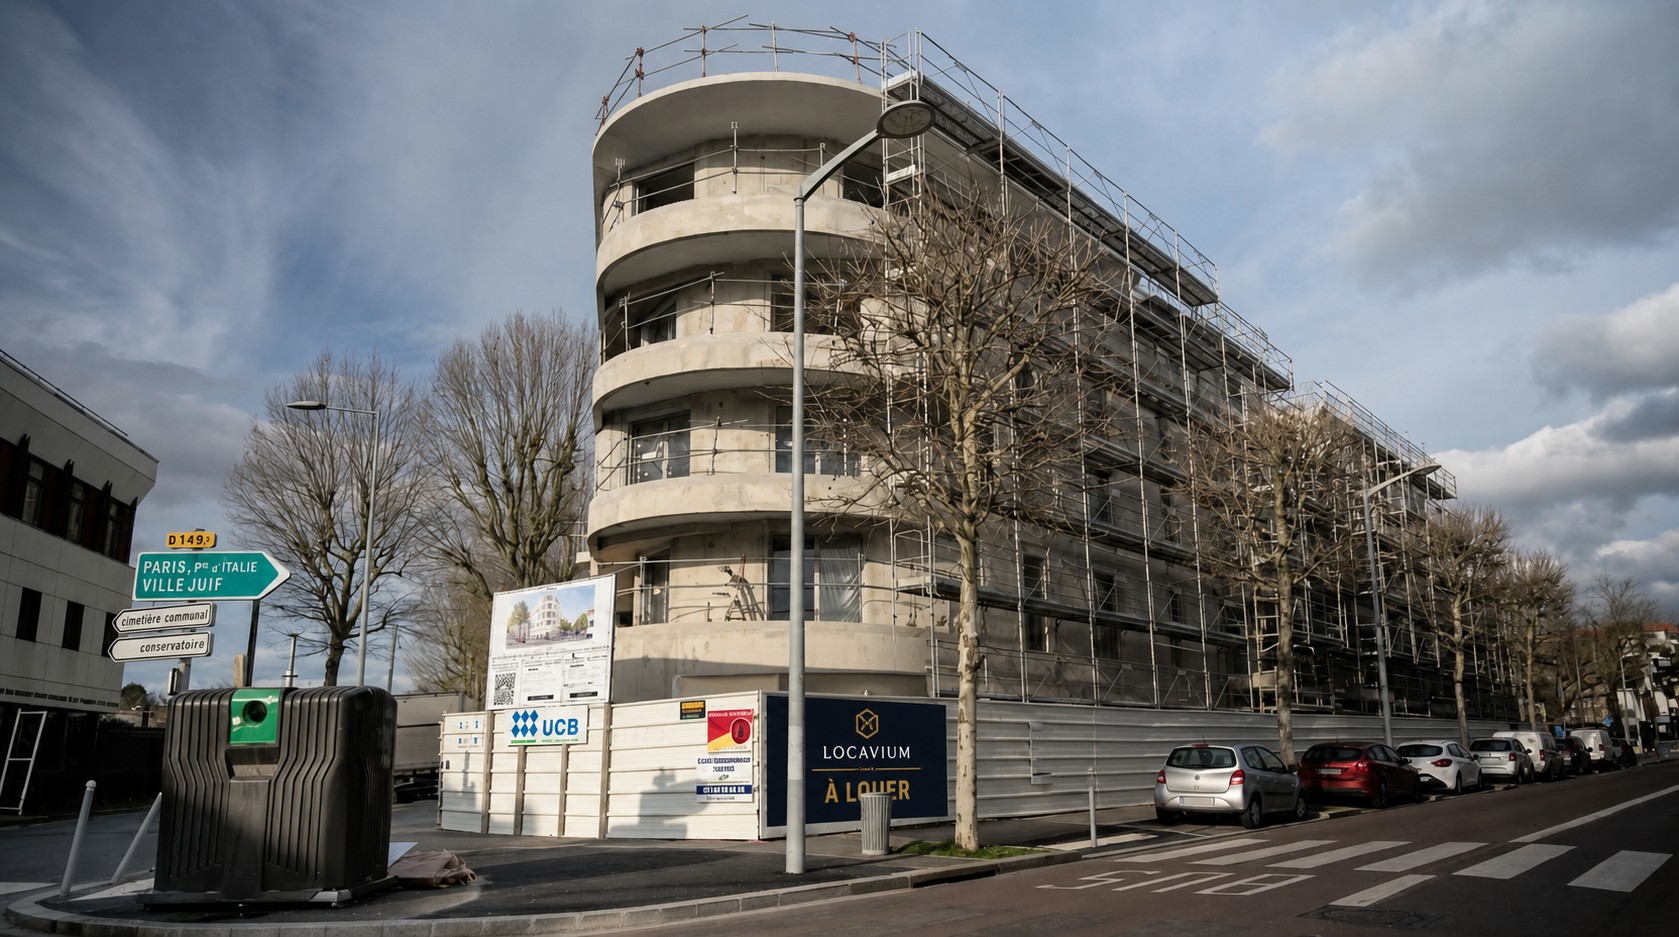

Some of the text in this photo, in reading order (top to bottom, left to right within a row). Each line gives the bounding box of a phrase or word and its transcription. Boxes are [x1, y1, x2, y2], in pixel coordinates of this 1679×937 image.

[169, 535, 176, 545] D
[143, 560, 191, 575] PARIS,
[212, 561, 258, 573] d'ITALIE
[143, 578, 223, 592] VILLE JUIF
[121, 609, 208, 627] cimetière communal
[140, 639, 205, 653] conservatoire
[542, 718, 579, 736] UCB
[823, 745, 911, 760] LOCAVIUM
[824, 778, 839, 804] À
[1036, 870, 1316, 896] BUS
